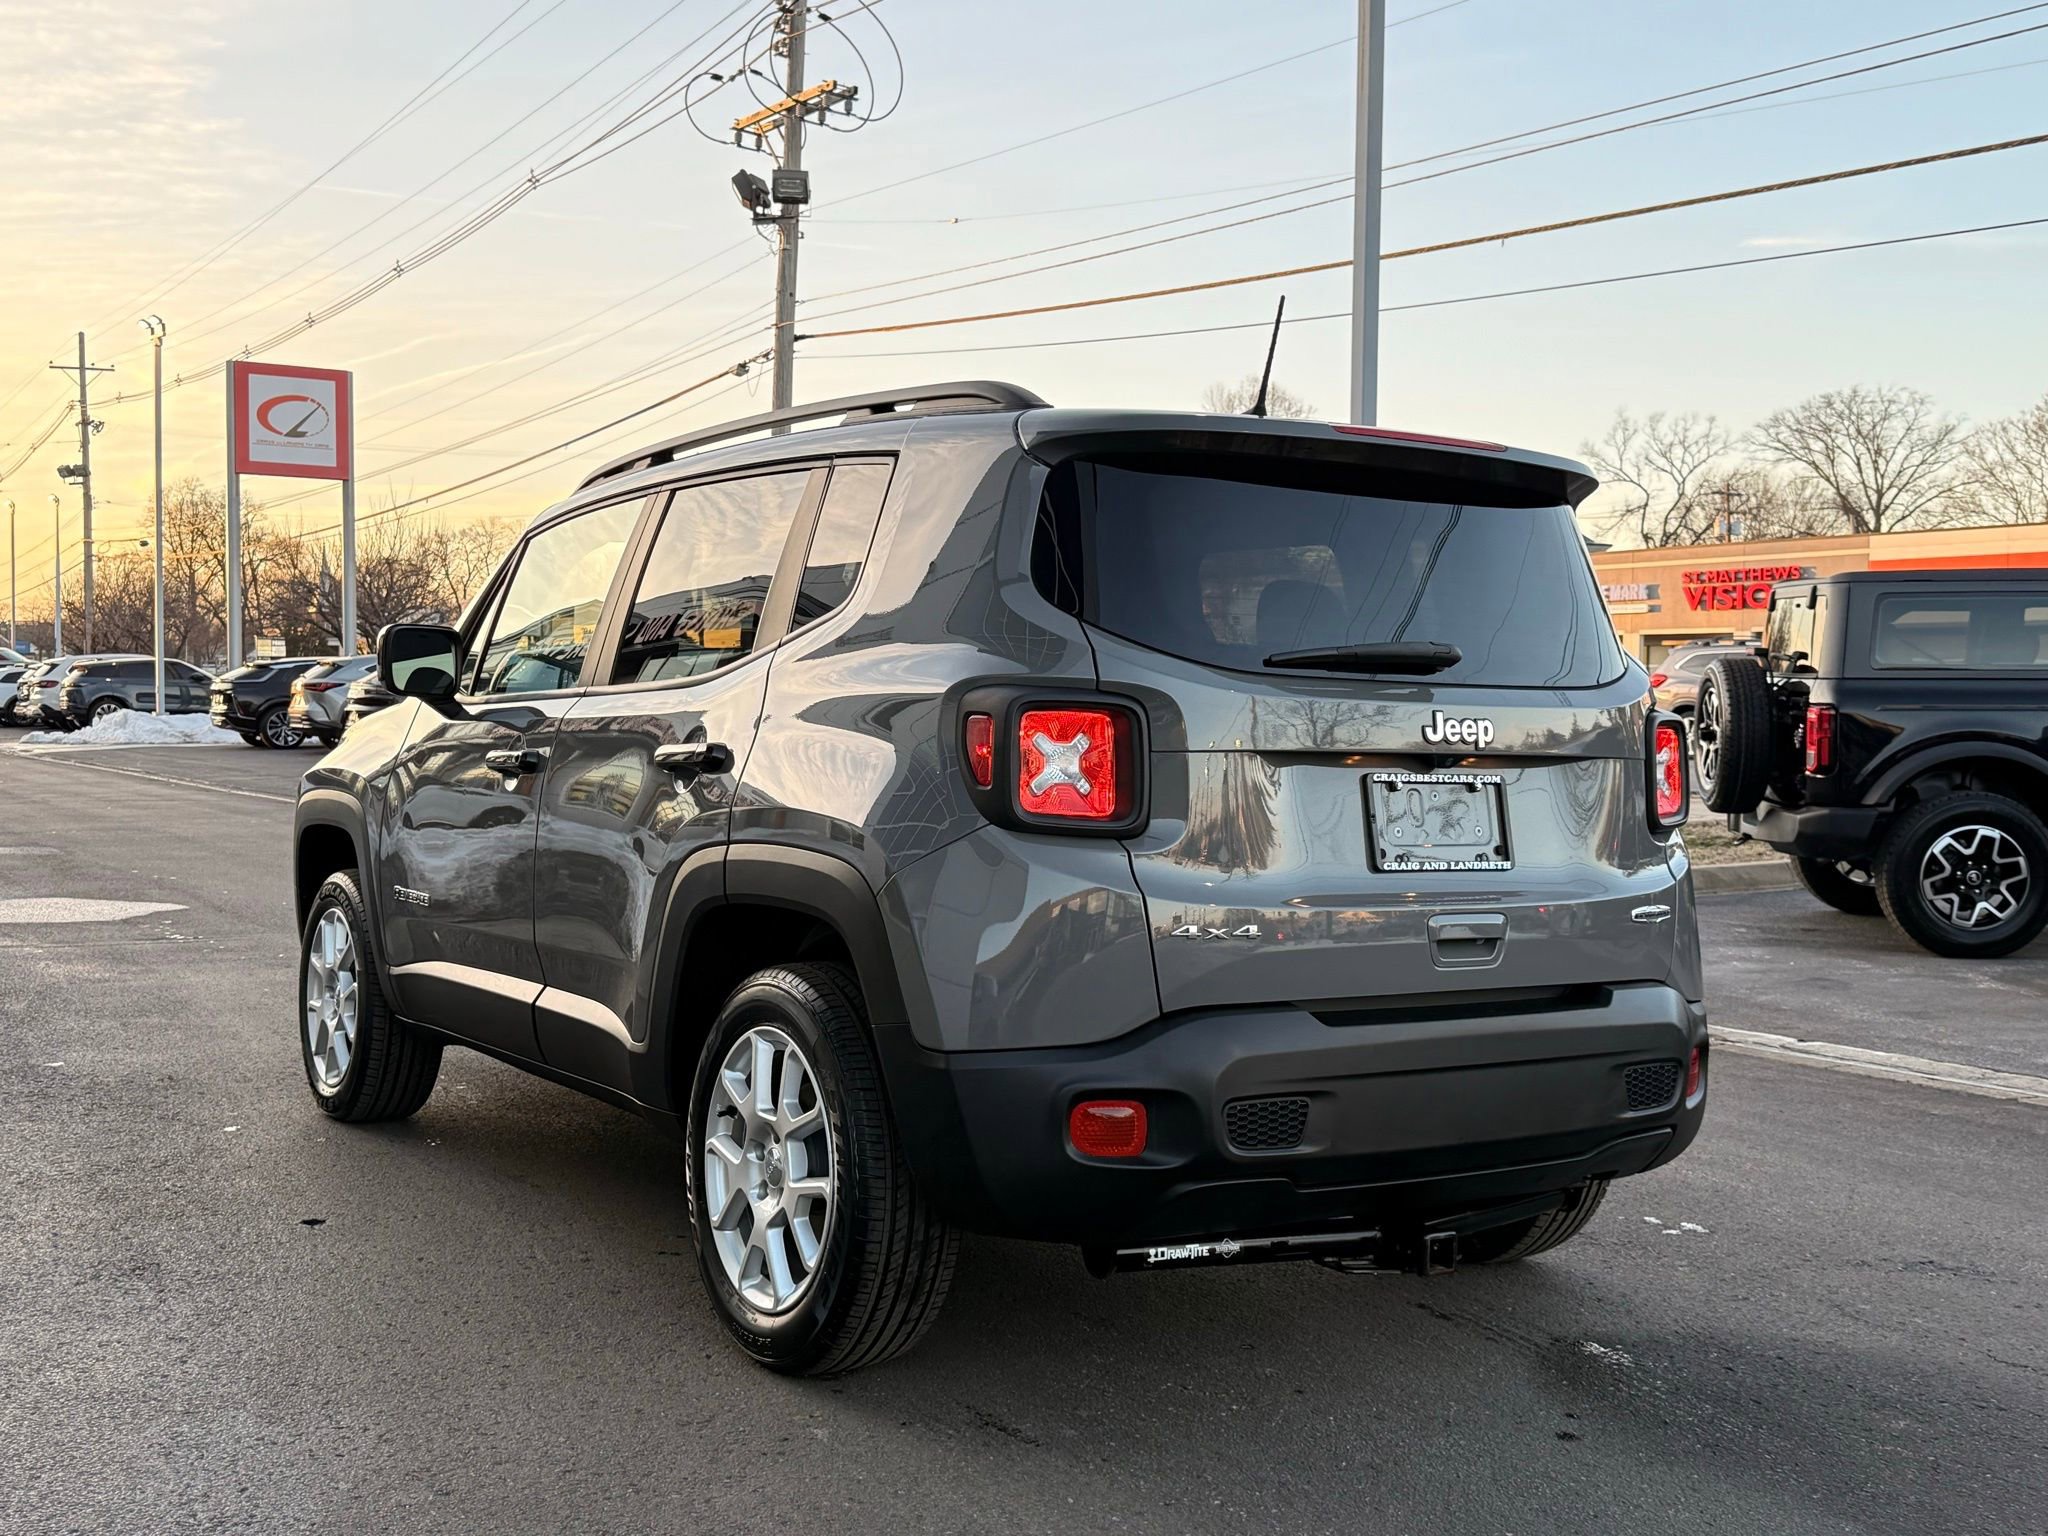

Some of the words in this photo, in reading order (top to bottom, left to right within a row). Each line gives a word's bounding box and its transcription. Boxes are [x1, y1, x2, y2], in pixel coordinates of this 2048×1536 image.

[1705, 565, 1801, 582] MATTHEWS
[1423, 710, 1495, 750] Jeep
[1373, 773, 1501, 784] CRAIGSBESTCARS.COM
[1383, 862, 1420, 871] CRAIG
[1423, 861, 1448, 871] AND
[1450, 861, 1512, 870] LANDRETH
